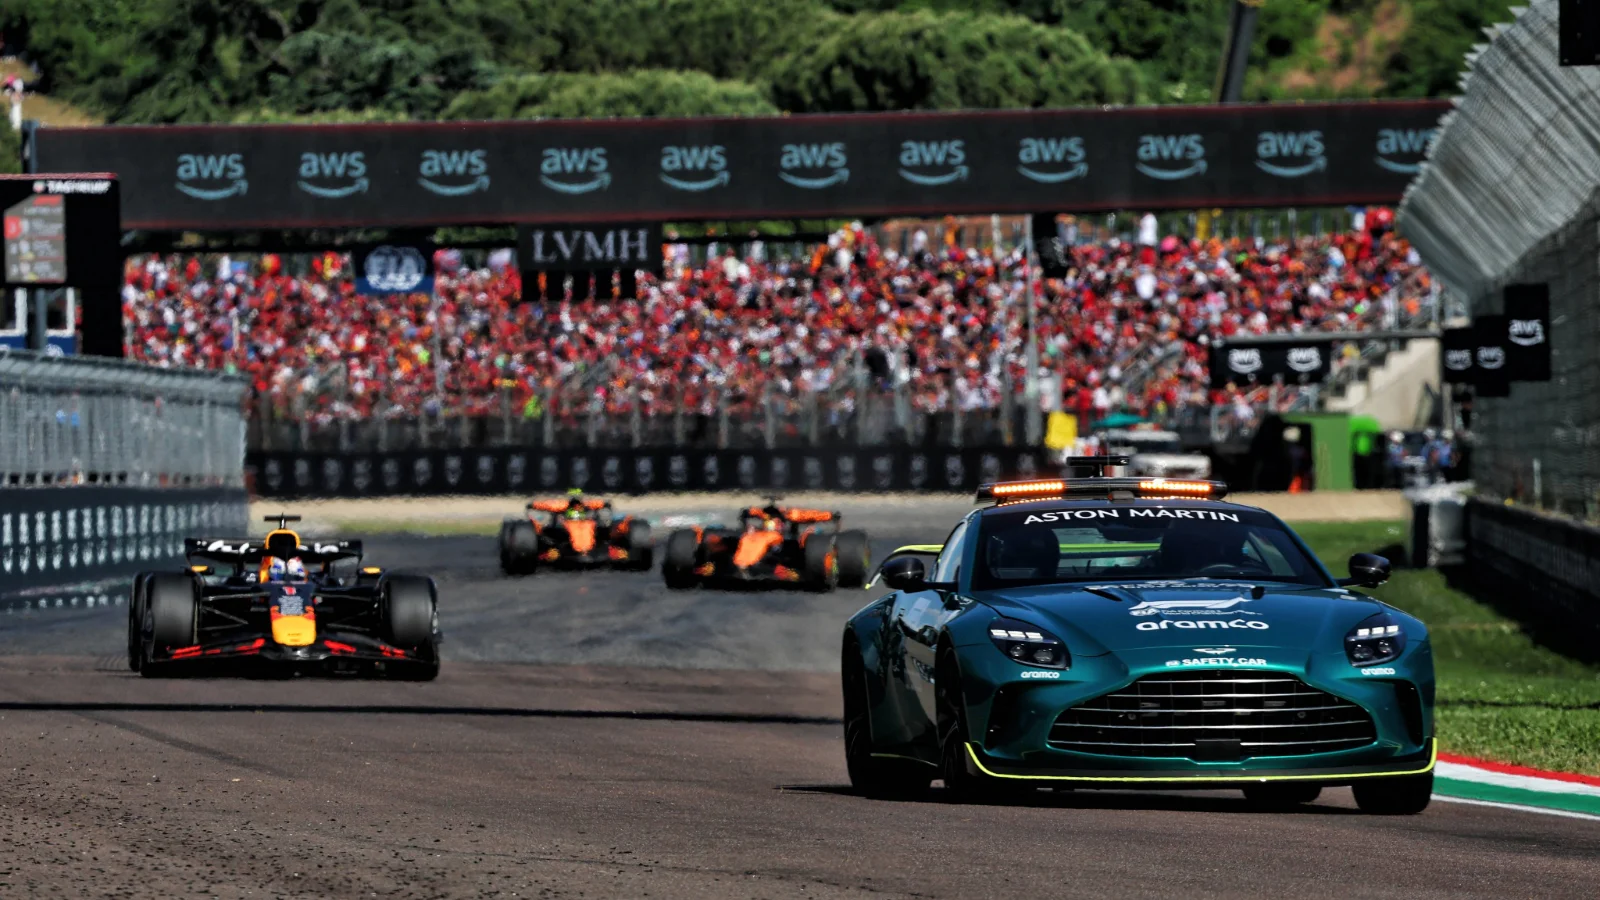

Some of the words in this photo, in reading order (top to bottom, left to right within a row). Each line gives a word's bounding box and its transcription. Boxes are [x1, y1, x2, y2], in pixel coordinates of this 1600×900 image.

[781, 143, 846, 168] aws
[900, 140, 965, 166] aws
[1019, 137, 1085, 162] aws
[1137, 135, 1204, 160] aws
[1257, 131, 1324, 157] aws
[177, 154, 245, 179] aws
[299, 152, 366, 177] aws
[420, 150, 486, 176] aws
[541, 148, 608, 173] aws
[661, 146, 726, 170] aws
[532, 229, 649, 261] LVMH
[1023, 509, 1120, 525] ASTON
[1129, 509, 1240, 523] MARTIN
[1135, 619, 1270, 631] aramco
[1182, 657, 1235, 666] SAFETY
[1237, 658, 1268, 666] CAR
[1361, 667, 1396, 676] aramco
[1020, 671, 1060, 679] aramco
